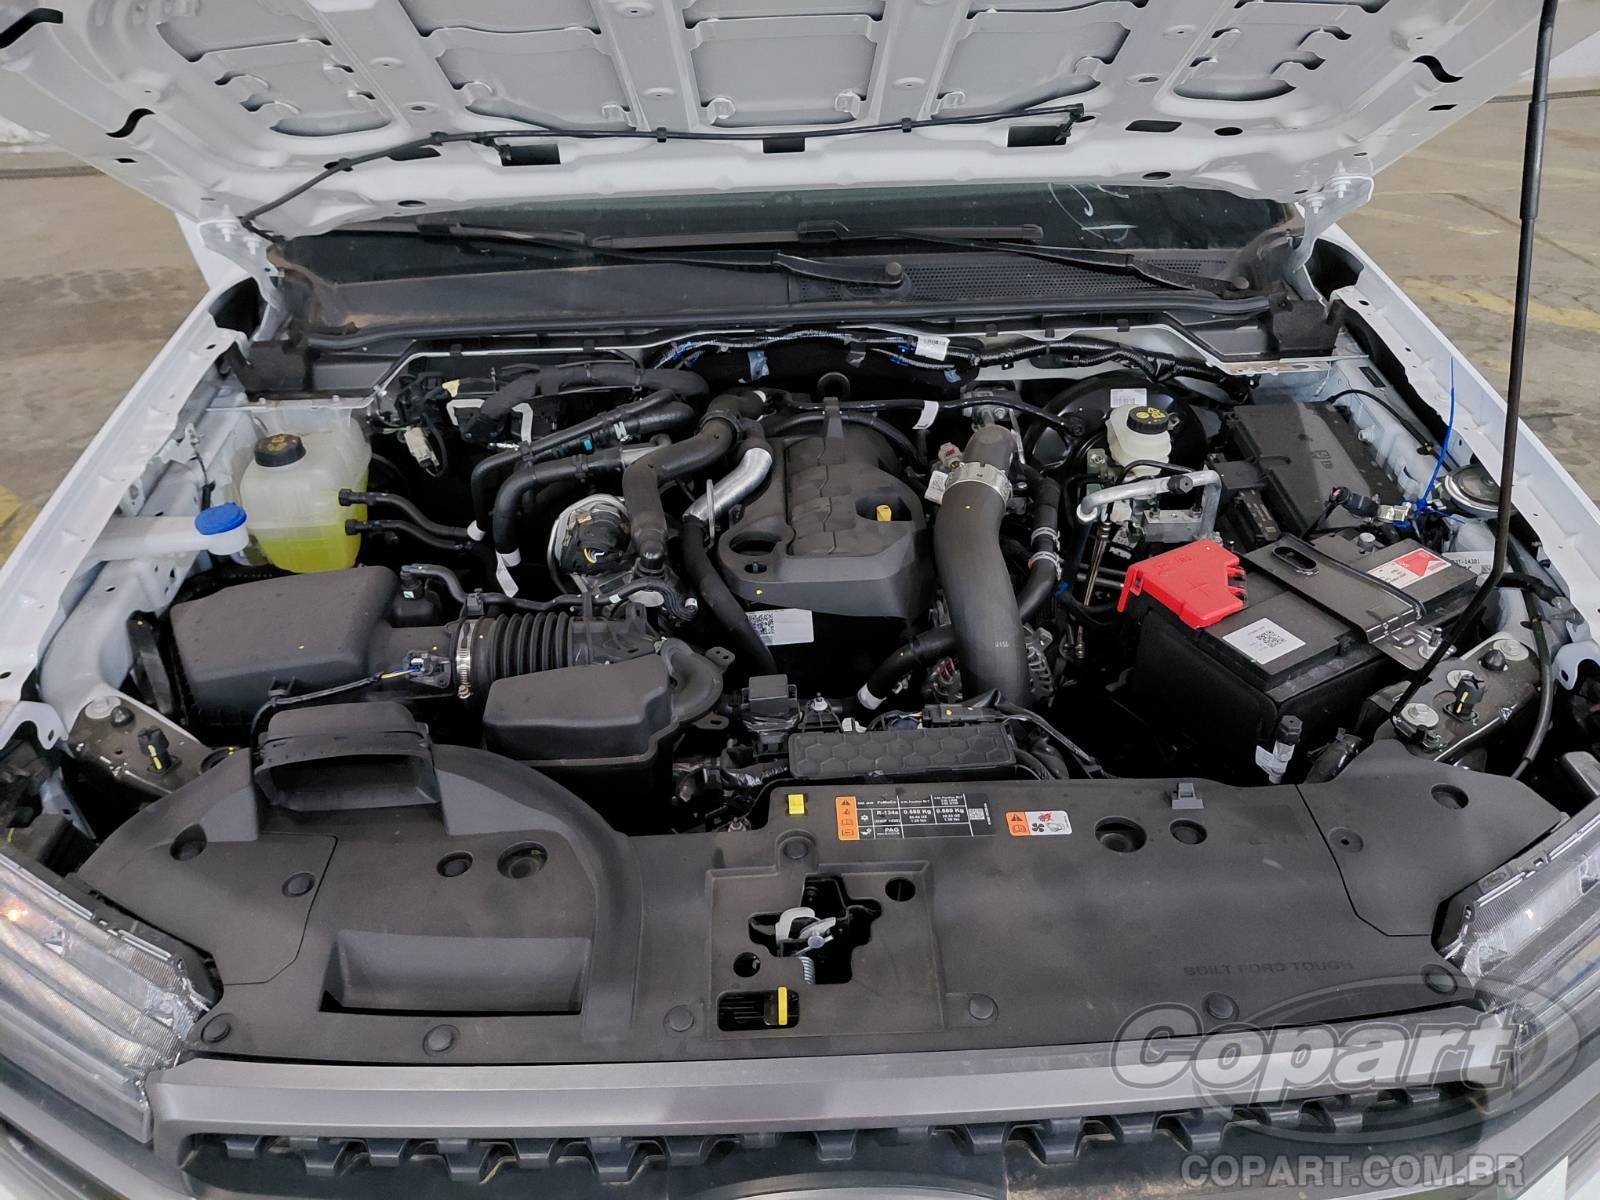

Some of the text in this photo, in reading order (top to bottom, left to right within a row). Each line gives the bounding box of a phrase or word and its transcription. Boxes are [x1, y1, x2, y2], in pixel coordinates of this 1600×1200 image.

[1184, 960, 1354, 976] BUILT FORD TOUGH
